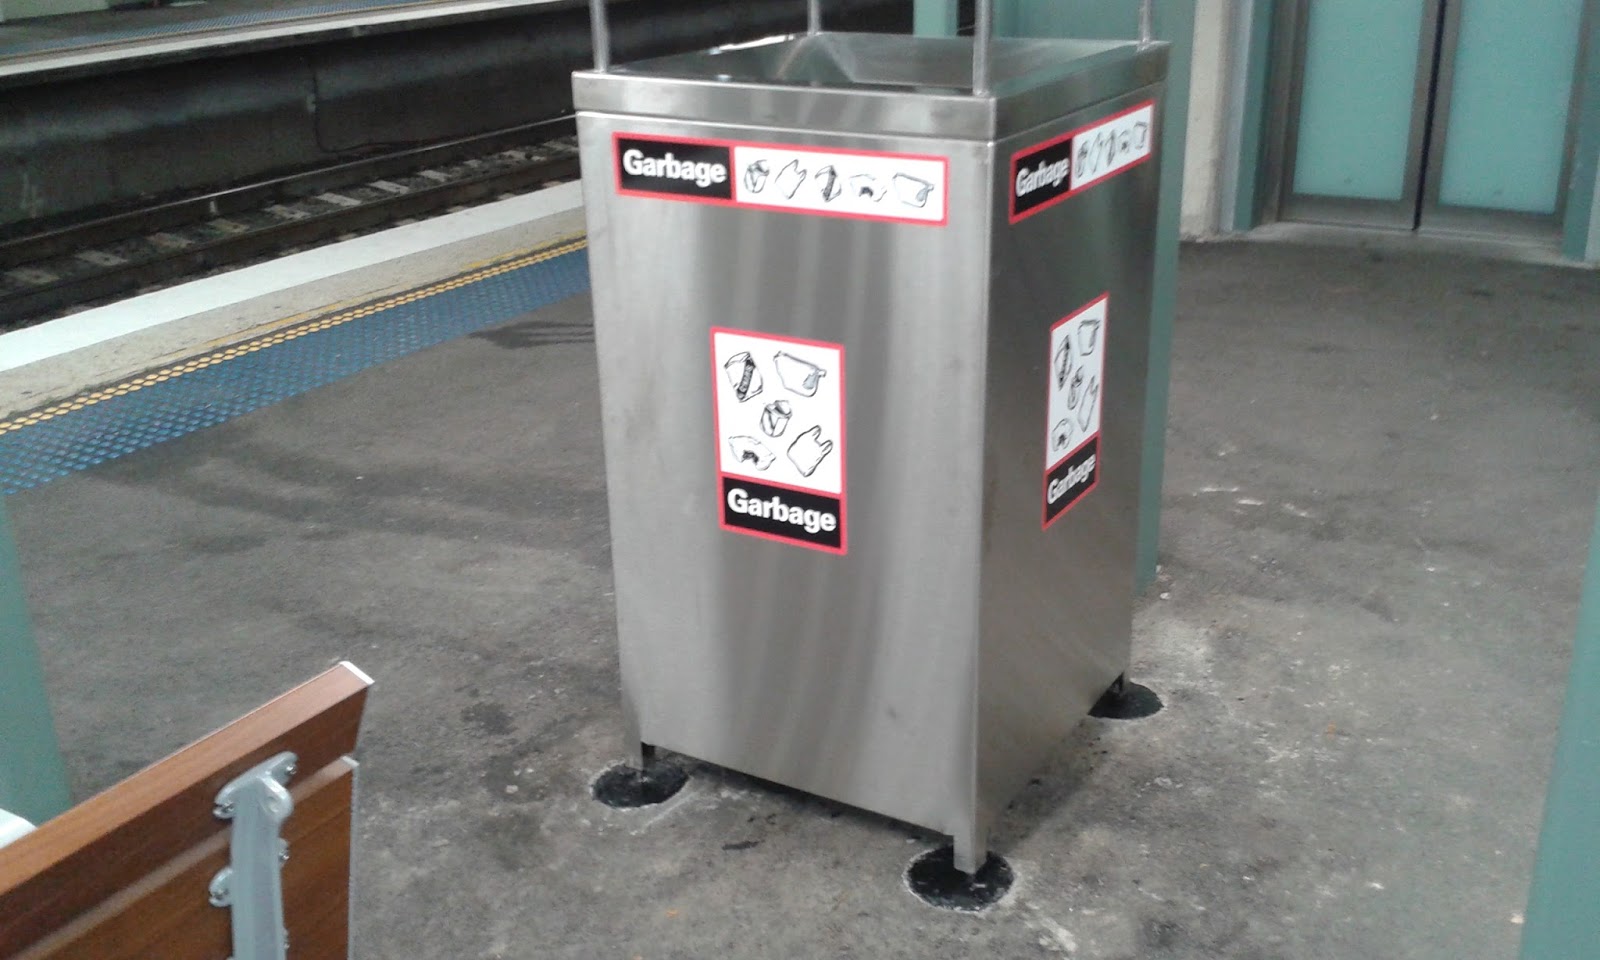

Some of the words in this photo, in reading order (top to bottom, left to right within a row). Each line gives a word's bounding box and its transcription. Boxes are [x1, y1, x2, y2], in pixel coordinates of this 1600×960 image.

[622, 148, 727, 188] Garbage
[1015, 157, 1070, 197] Garbage
[1047, 454, 1096, 504] Garbage
[727, 488, 836, 533] Garbage
